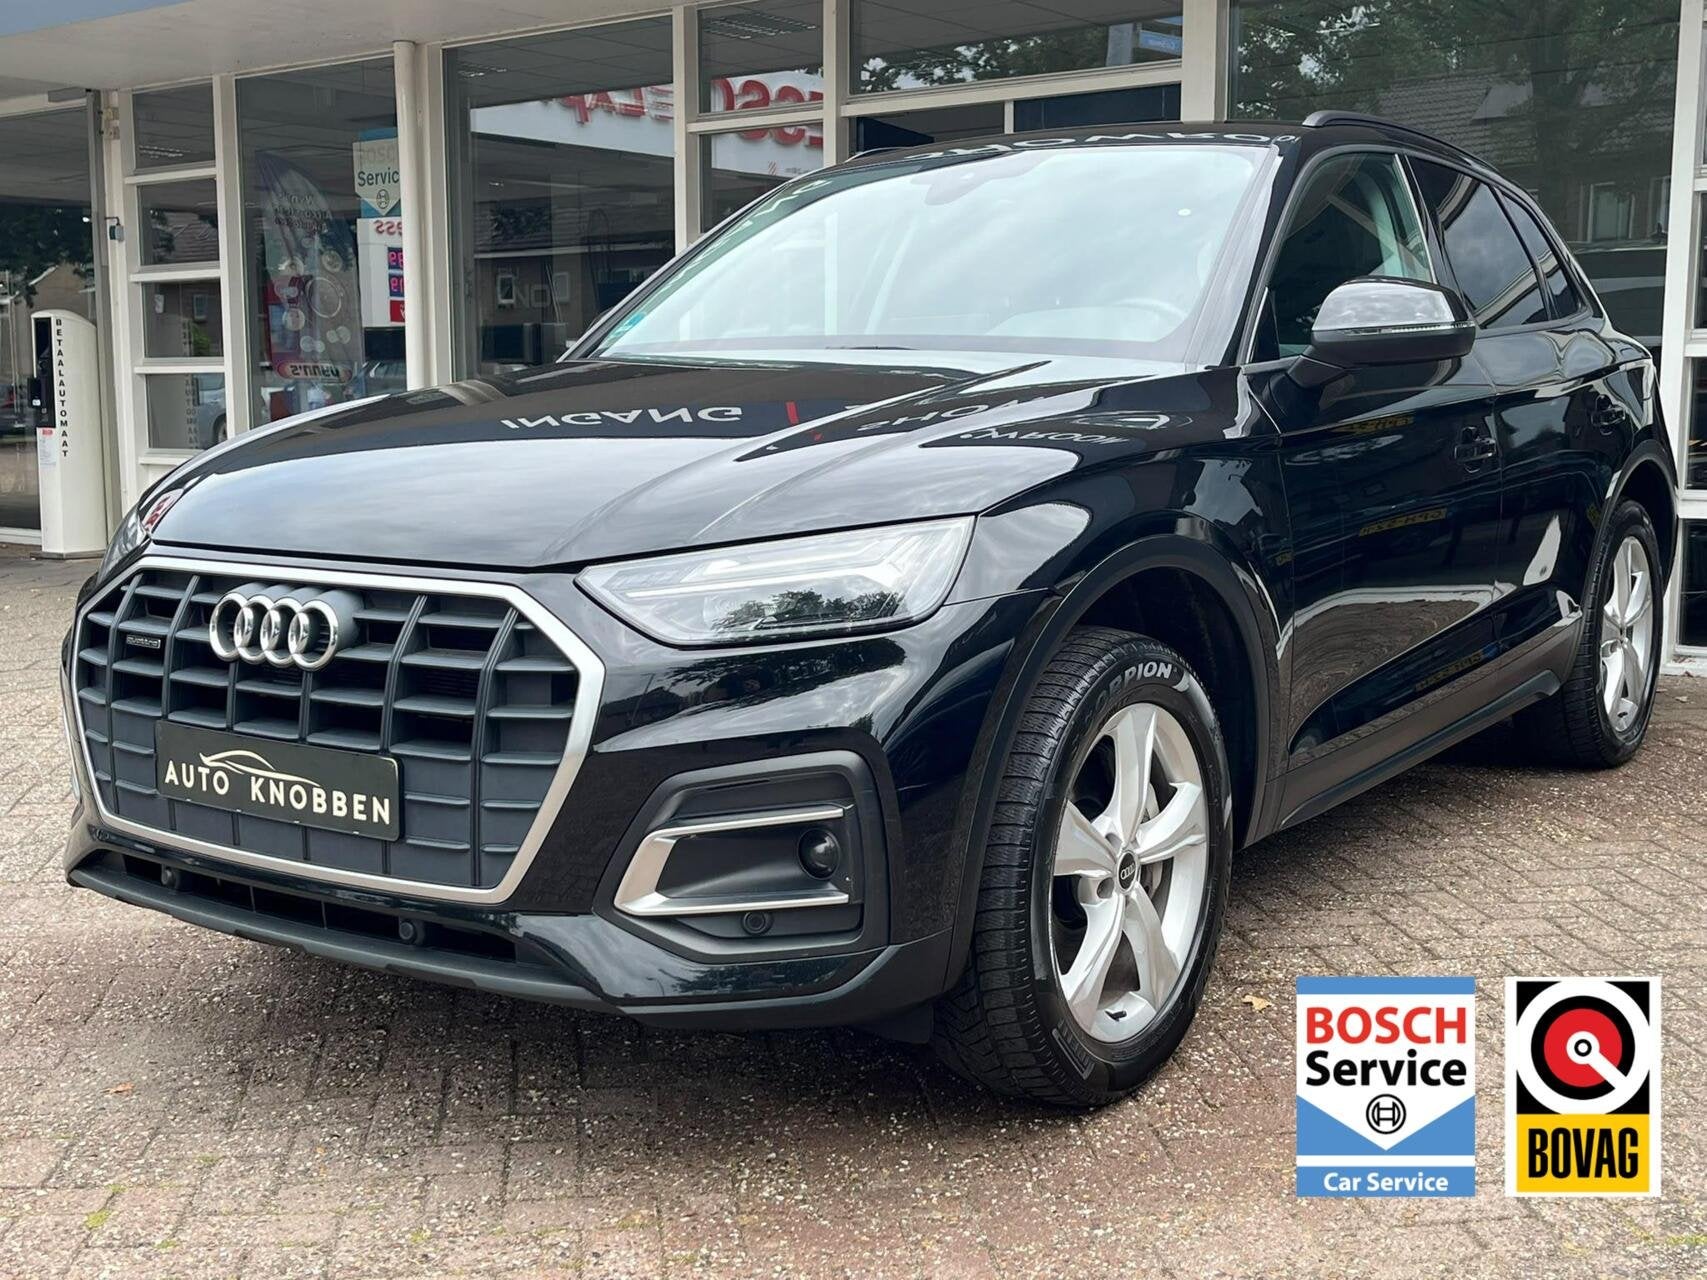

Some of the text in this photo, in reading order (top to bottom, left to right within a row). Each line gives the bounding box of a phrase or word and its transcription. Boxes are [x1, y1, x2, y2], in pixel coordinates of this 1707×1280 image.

[55, 318, 69, 457] BETAALAUTOMAAT
[164, 759, 391, 825] AUTO KNOBBEN
